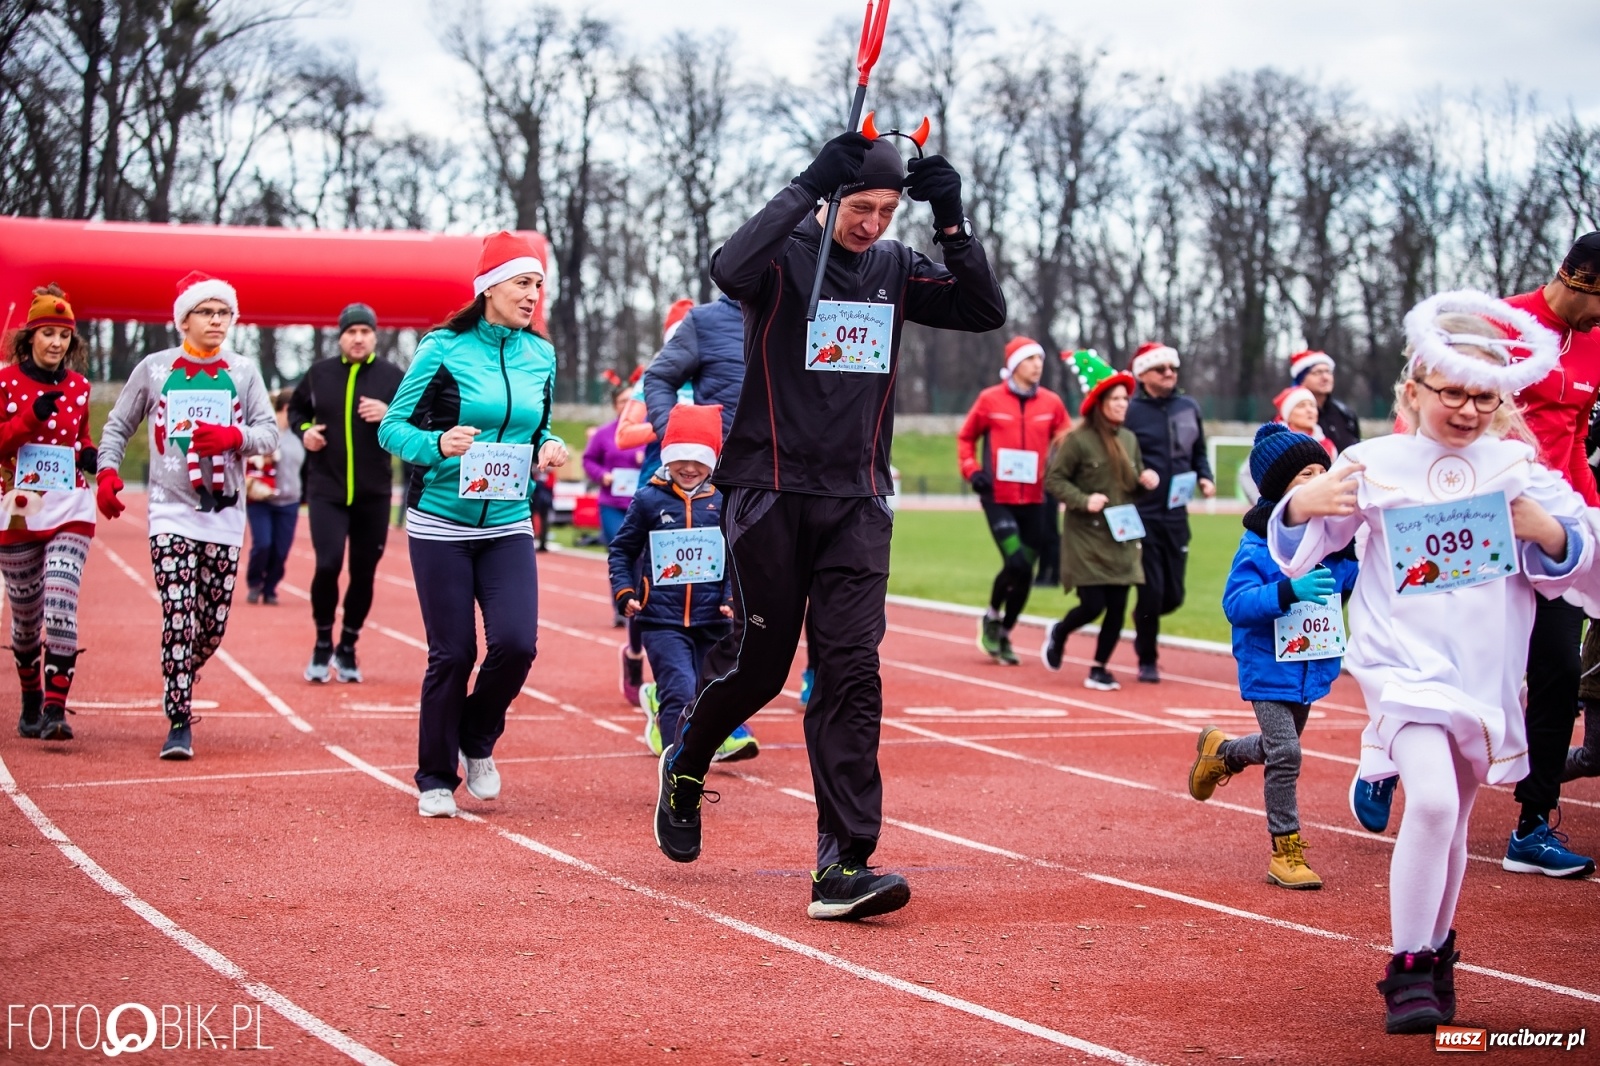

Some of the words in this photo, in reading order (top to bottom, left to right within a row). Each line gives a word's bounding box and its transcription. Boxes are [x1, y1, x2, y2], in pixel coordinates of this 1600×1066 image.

[836, 325, 868, 344] 047
[188, 406, 212, 418] 057
[36, 460, 59, 473] 053
[484, 462, 510, 477] 003
[1425, 528, 1474, 557] 039
[676, 547, 703, 562] 007
[1302, 616, 1330, 634] 062
